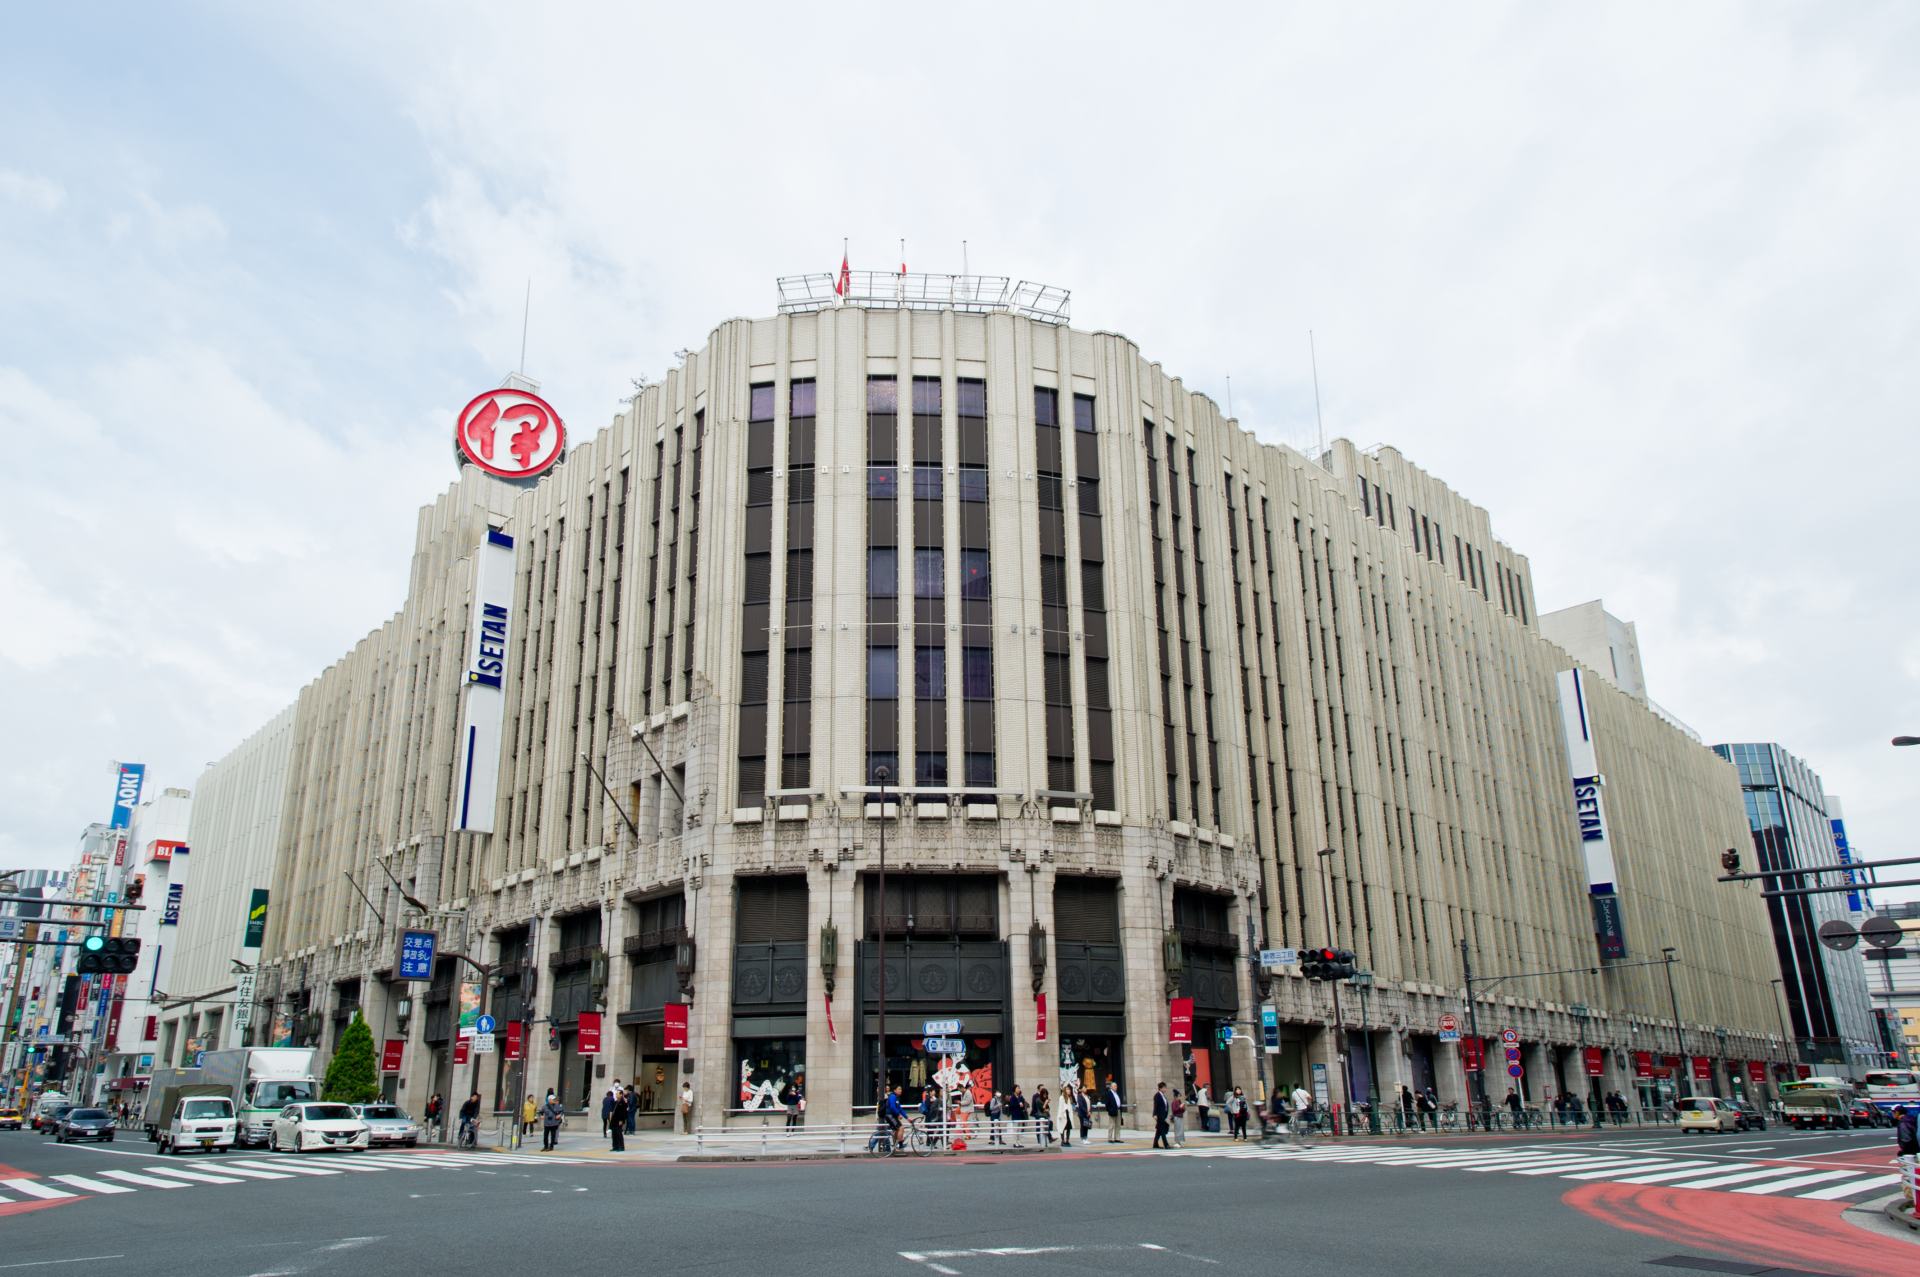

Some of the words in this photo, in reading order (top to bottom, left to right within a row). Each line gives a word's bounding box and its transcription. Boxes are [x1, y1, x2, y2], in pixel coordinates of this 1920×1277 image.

[118, 773, 139, 808] AOKI
[403, 938, 432, 949] 交差点
[402, 950, 430, 961] 事故多し
[402, 962, 427, 973] 注意
